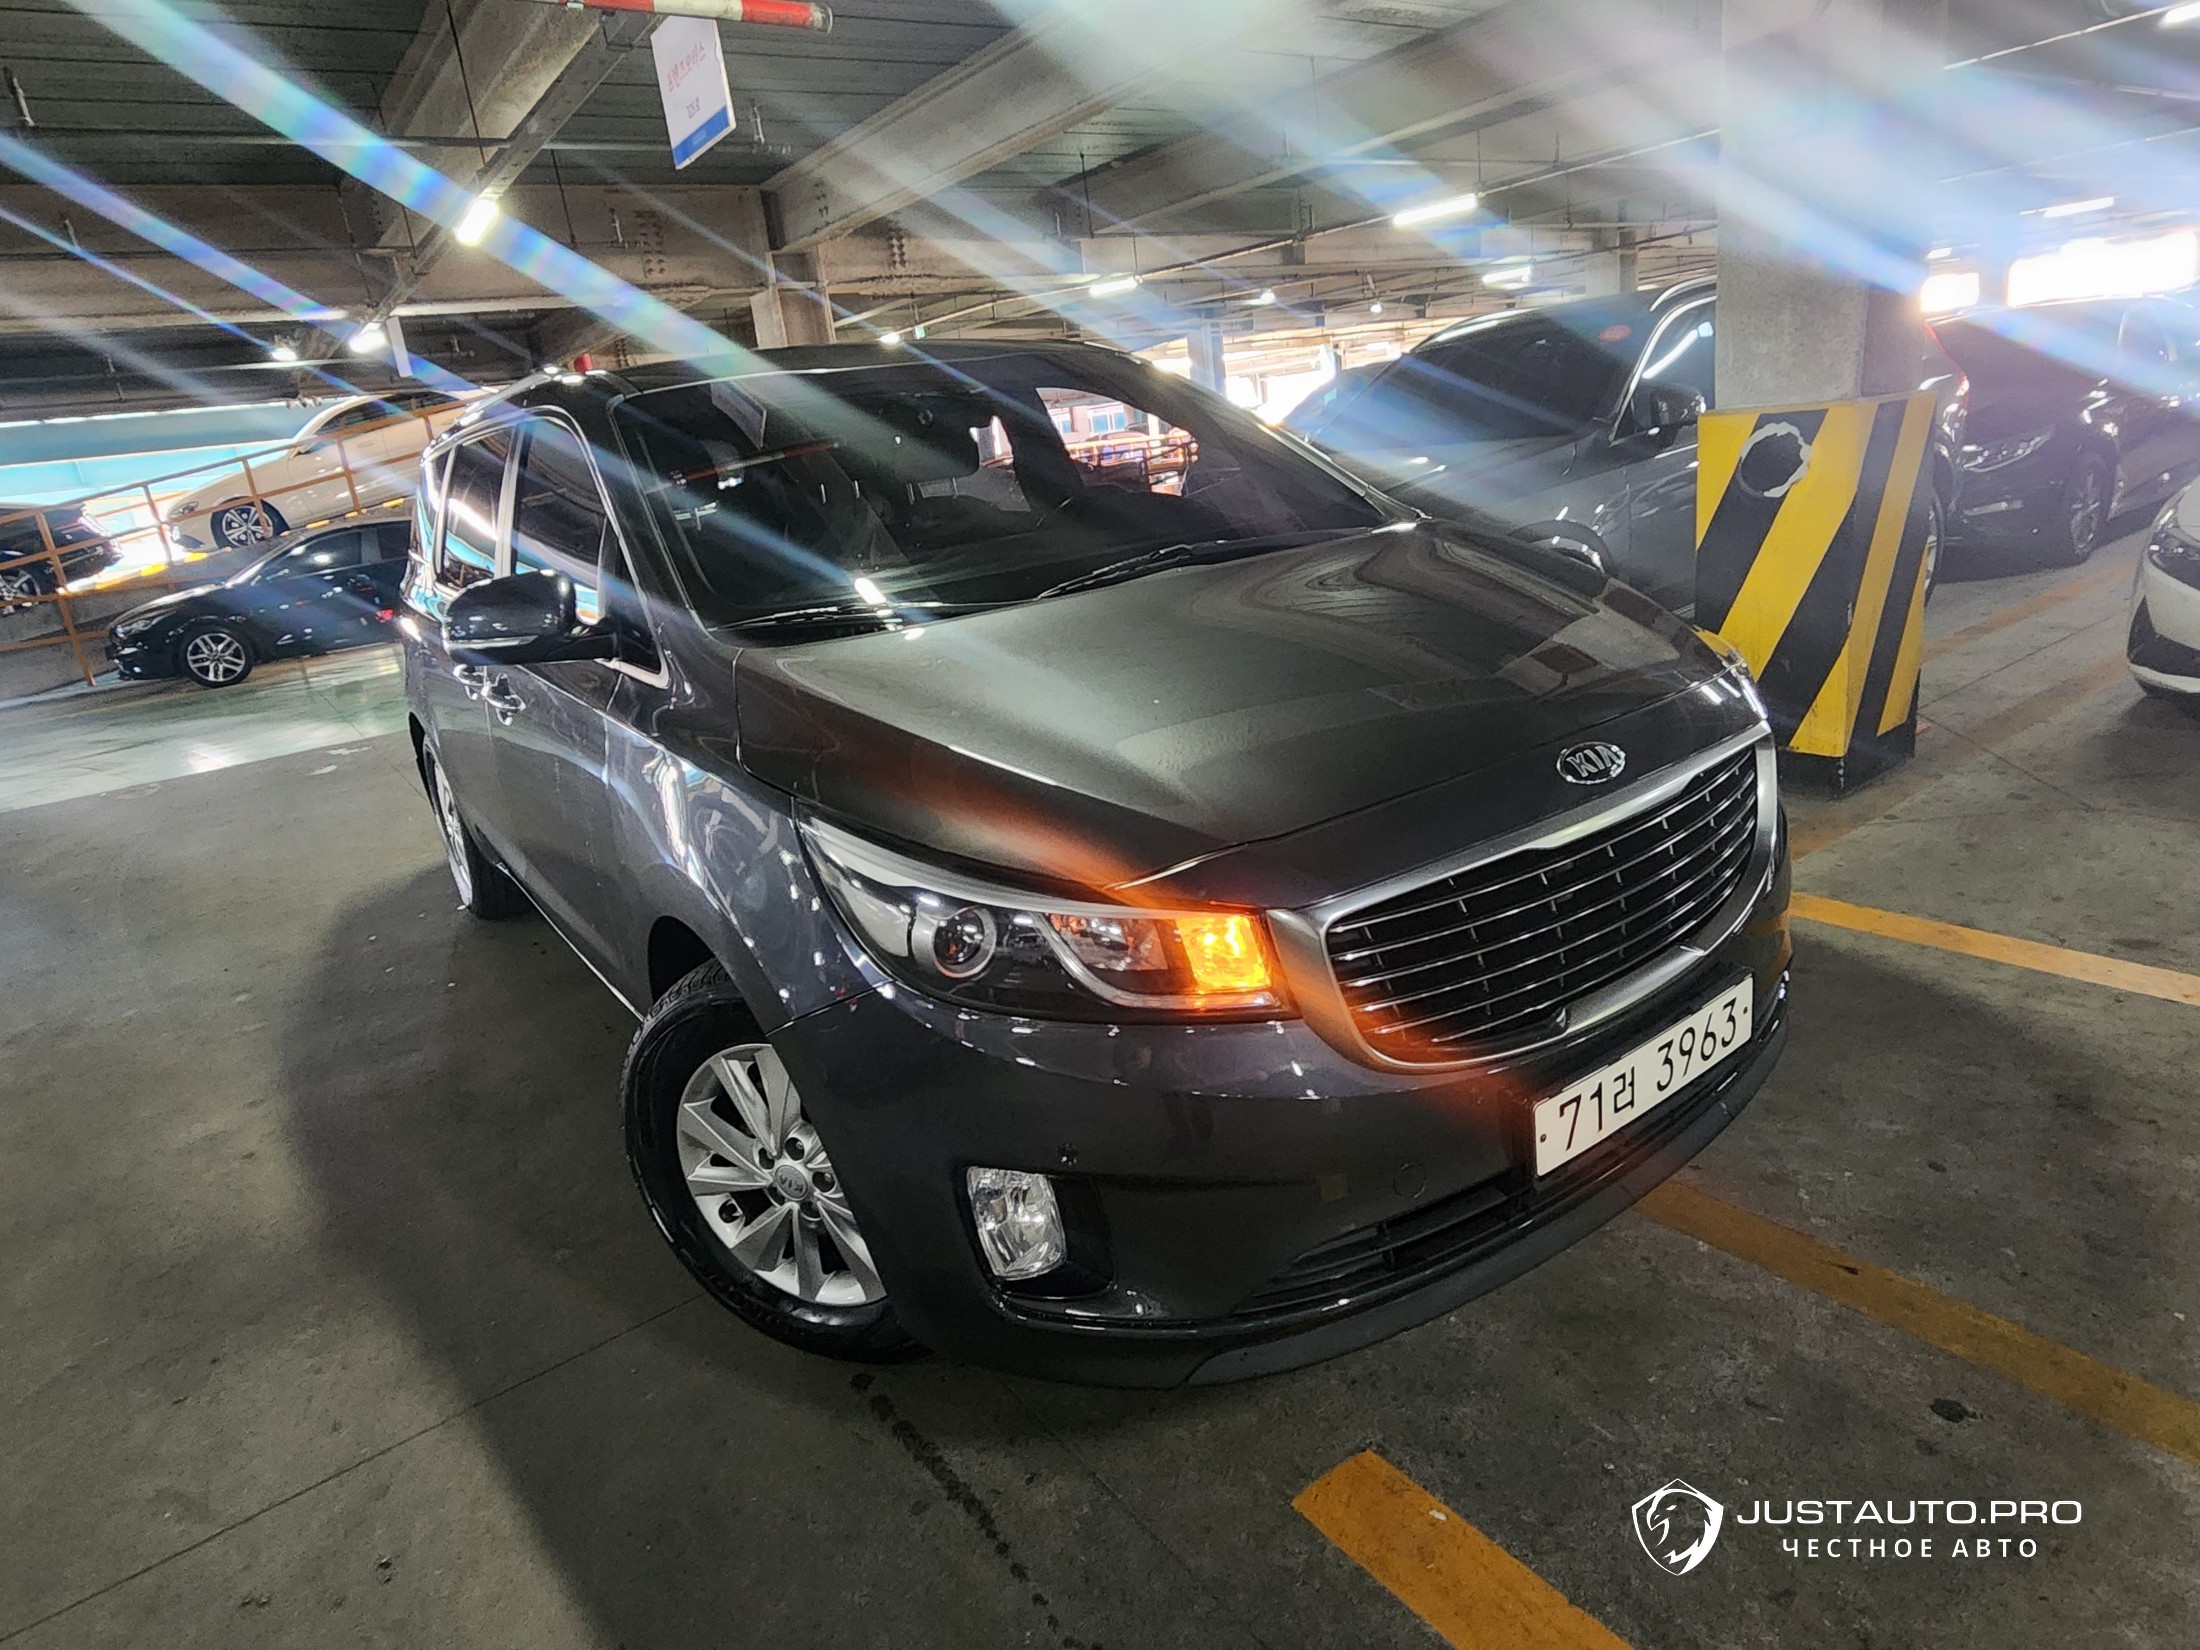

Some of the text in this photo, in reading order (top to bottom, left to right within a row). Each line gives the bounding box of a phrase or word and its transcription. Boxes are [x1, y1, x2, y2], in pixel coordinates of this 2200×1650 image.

[1565, 745, 1623, 778] KIA
[1558, 996, 1737, 1152] 71러 3963
